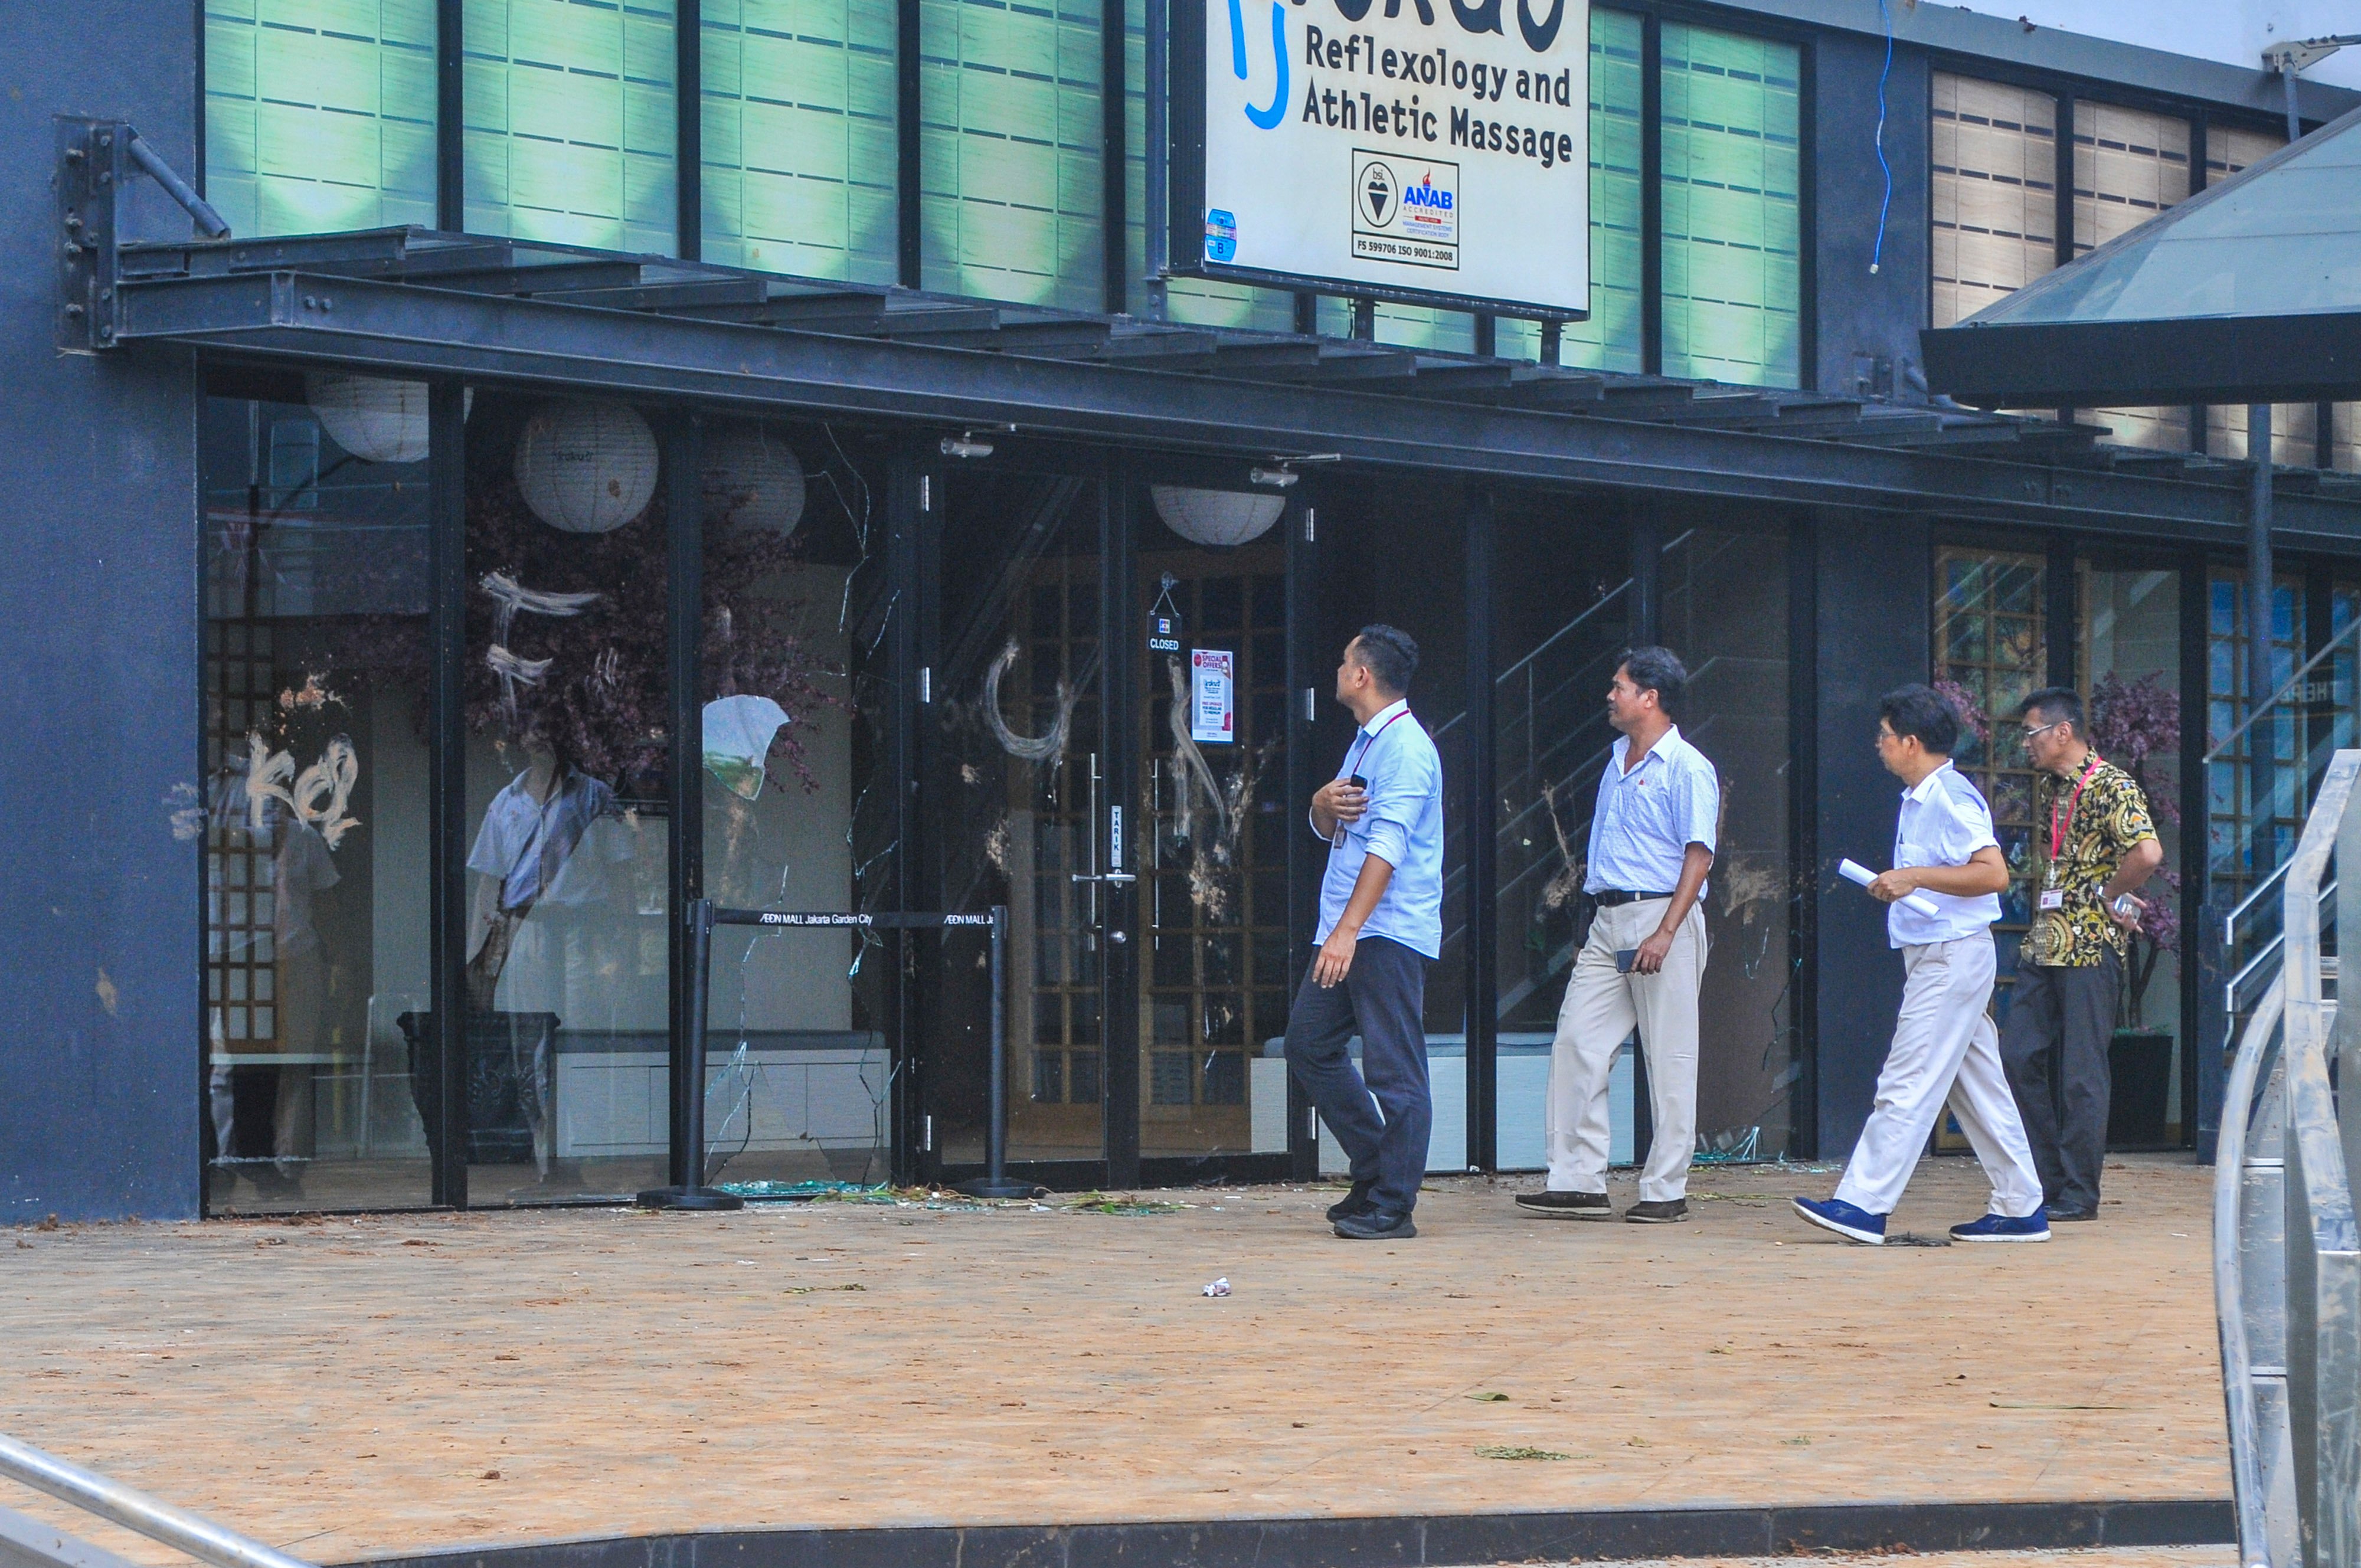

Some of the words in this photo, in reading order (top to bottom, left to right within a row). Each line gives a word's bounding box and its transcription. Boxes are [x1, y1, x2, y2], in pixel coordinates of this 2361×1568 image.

[1306, 24, 1507, 102] Reflexology
[1516, 68, 1571, 107] and
[1303, 75, 1438, 142] Athletic
[1450, 106, 1572, 168] Massage
[1403, 186, 1453, 209] ANAB
[1403, 206, 1453, 218] ACCREDITED
[1358, 240, 1366, 250] FS
[1368, 241, 1397, 254] 599706
[1398, 245, 1412, 256] ISO
[1414, 248, 1453, 261] 9001:2008
[1150, 638, 1179, 650] CLOSED
[782, 914, 804, 924] MALL
[805, 914, 830, 924] Jakarta
[832, 914, 857, 924] Garden
[858, 914, 873, 927] City
[965, 915, 986, 924] MALL
